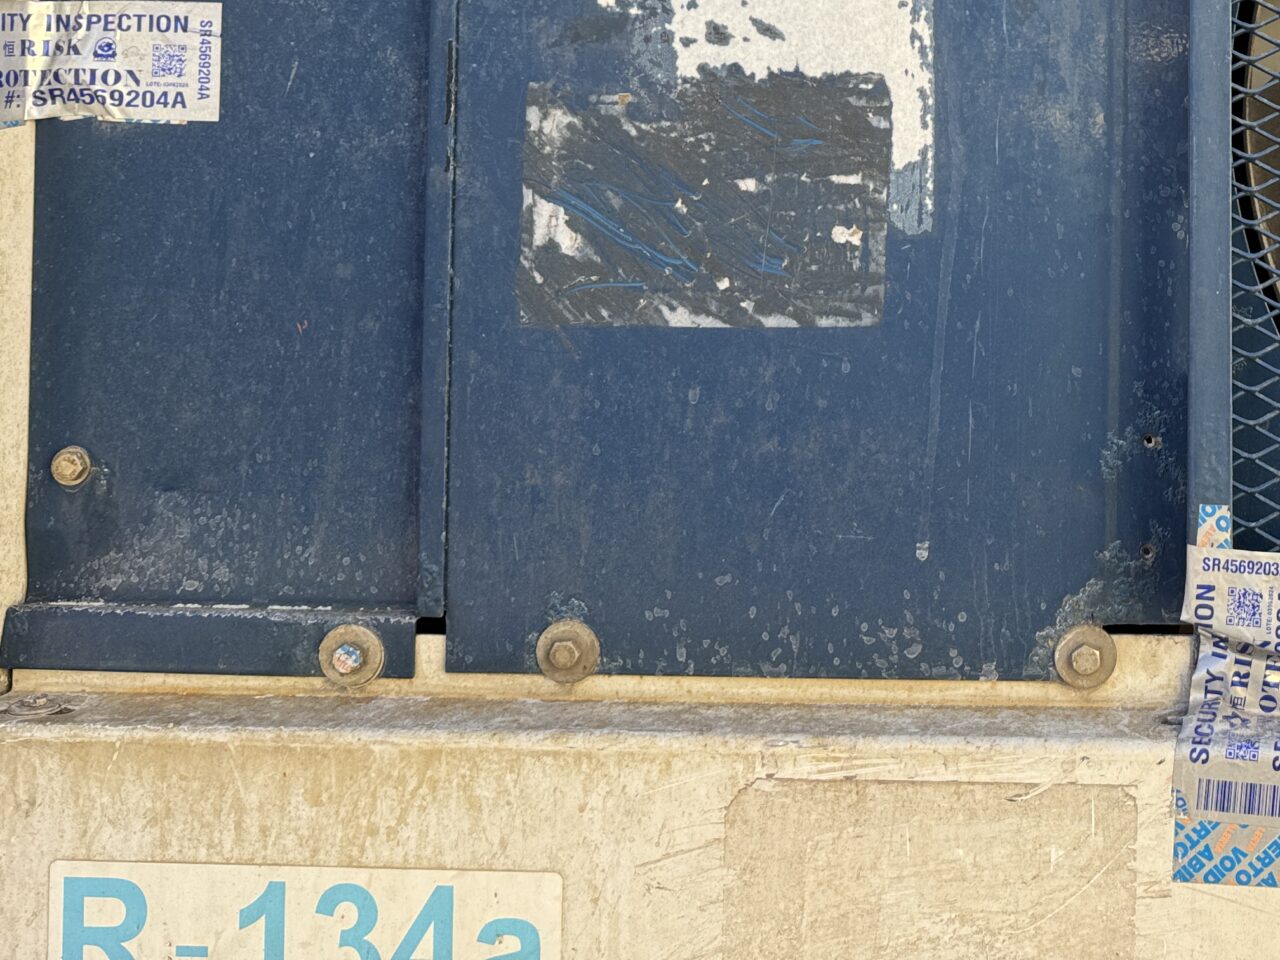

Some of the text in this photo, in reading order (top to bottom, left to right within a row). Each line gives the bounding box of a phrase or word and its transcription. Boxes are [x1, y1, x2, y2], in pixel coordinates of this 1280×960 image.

[46, 13, 189, 33] INSPECTION
[20, 38, 82, 57] RISK
[197, 19, 213, 100] SR4569204A
[32, 87, 187, 109] SR4569204A
[1230, 641, 1254, 688] RIS
[1203, 846, 1249, 884] VOID
